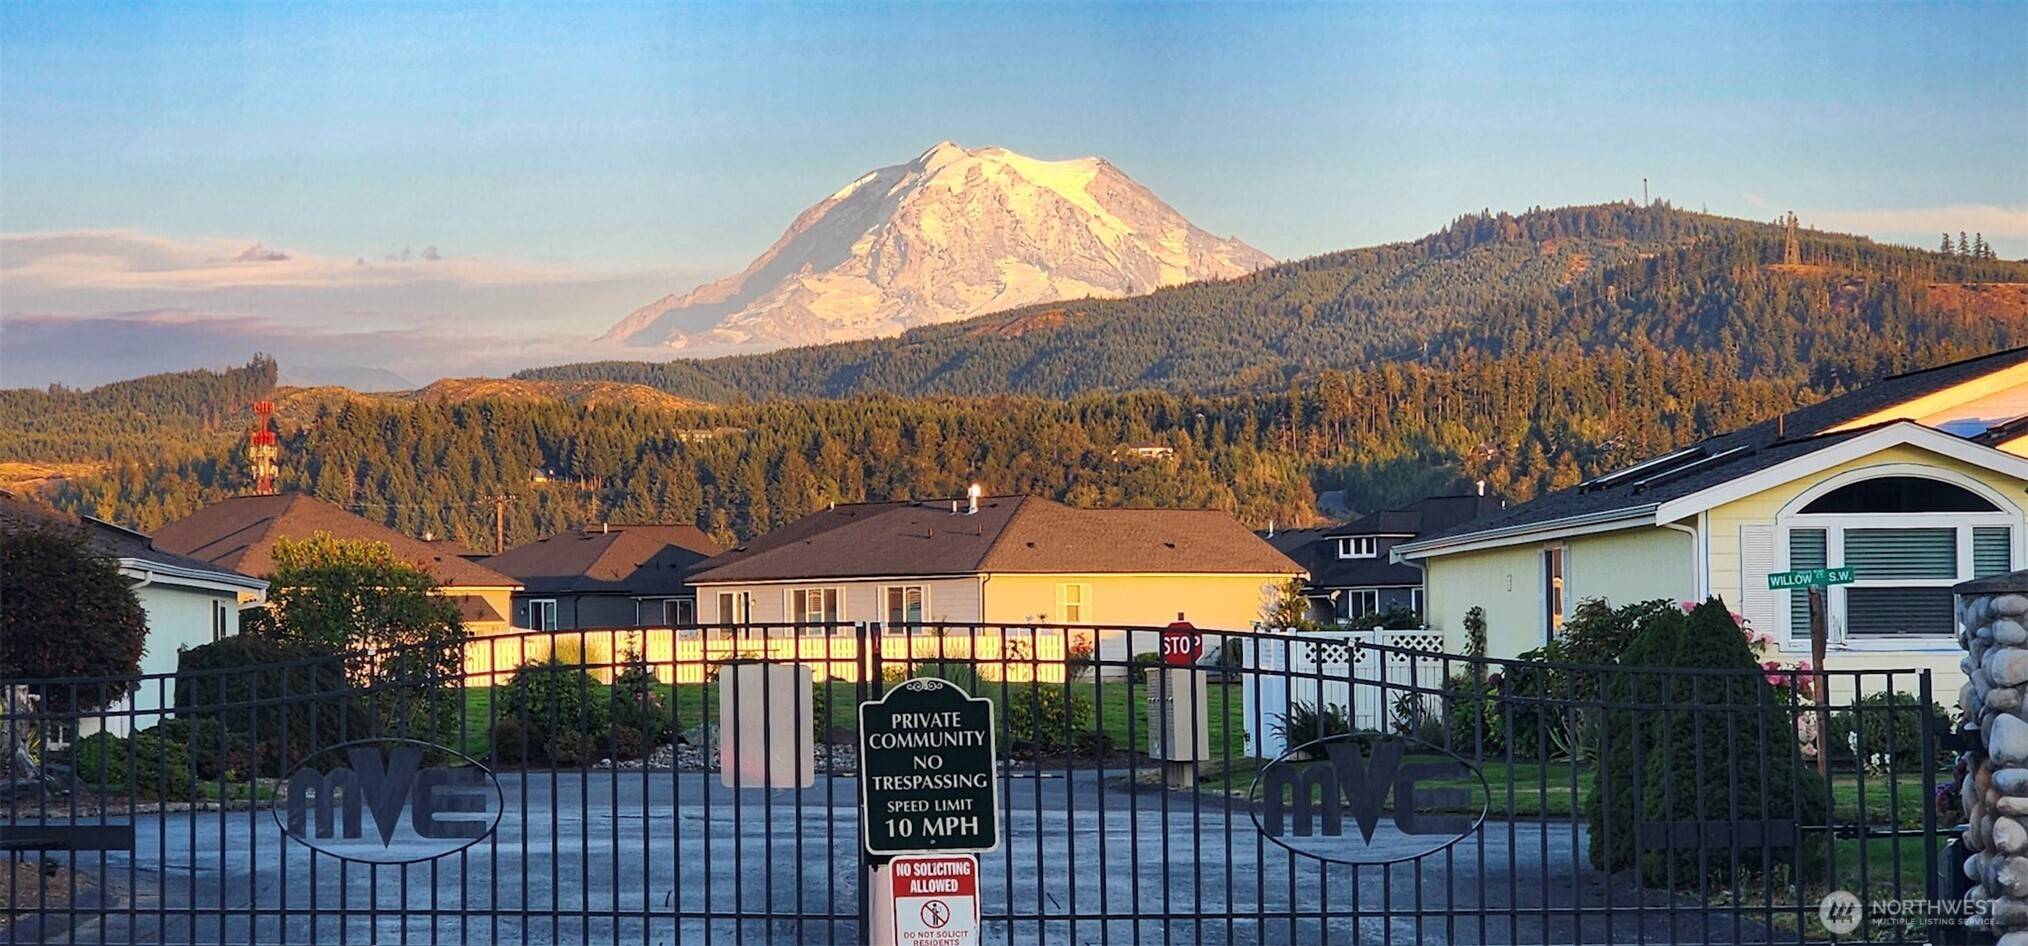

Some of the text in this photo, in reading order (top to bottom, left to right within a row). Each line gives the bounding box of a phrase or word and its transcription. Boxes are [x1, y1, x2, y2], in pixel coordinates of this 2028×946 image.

[1770, 572, 1812, 586] WILLOW
[1829, 571, 1852, 582] S.W.
[891, 712, 961, 729] PRIVATE
[869, 730, 986, 750] COMMUNITY
[913, 754, 943, 770] NO
[872, 773, 988, 791] TRESPASSING
[887, 799, 974, 813] SPEED LIMIT
[885, 816, 979, 838] 10 MPH
[896, 862, 970, 876] NO SOLICITING
[910, 878, 959, 893] ALLOWED
[904, 931, 916, 939] DO
[936, 930, 969, 938] SOLICIT
